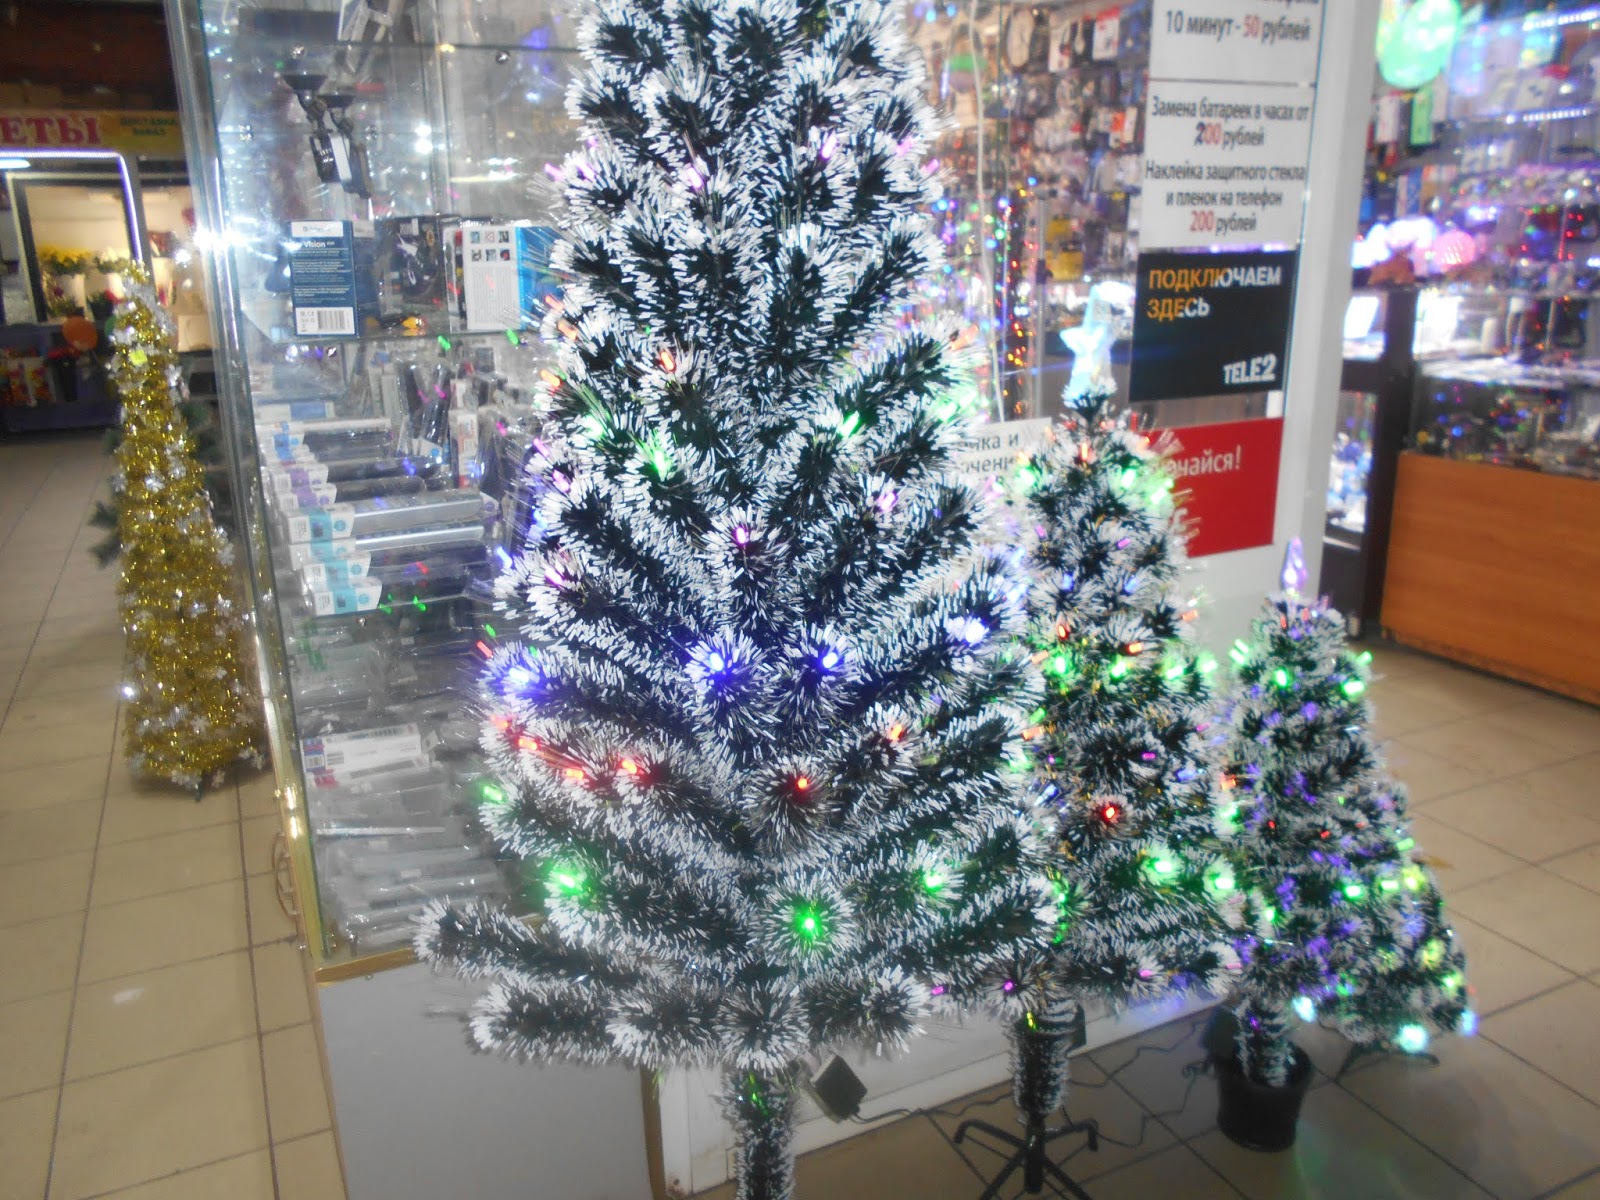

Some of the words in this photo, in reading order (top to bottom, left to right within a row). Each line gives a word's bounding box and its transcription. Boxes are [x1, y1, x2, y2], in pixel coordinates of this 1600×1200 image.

[1166, 10, 1184, 34] 10
[1187, 16, 1234, 42] минут
[1243, 14, 1260, 38] 50
[1261, 16, 1311, 44] рублей
[1152, 96, 1197, 117] Замена
[1200, 97, 1251, 122] батареек
[1264, 105, 1294, 120] часах
[1297, 107, 1309, 120] от
[1223, 126, 1265, 149] рублей
[1145, 160, 1203, 180] Наклейка
[1206, 165, 1267, 183] защитного
[1269, 166, 1306, 181] стекла
[1166, 191, 1174, 206] и
[1176, 191, 1218, 206] пленок
[1220, 193, 1234, 206] на
[1236, 187, 1283, 210] телефон
[1190, 210, 1215, 232] 200
[1216, 213, 1257, 235] рублей
[1149, 266, 1282, 292] ПОДКЛЮЧАЕМ
[1147, 297, 1210, 322] ЗДЕСЬ
[1223, 353, 1277, 384] TELE2
